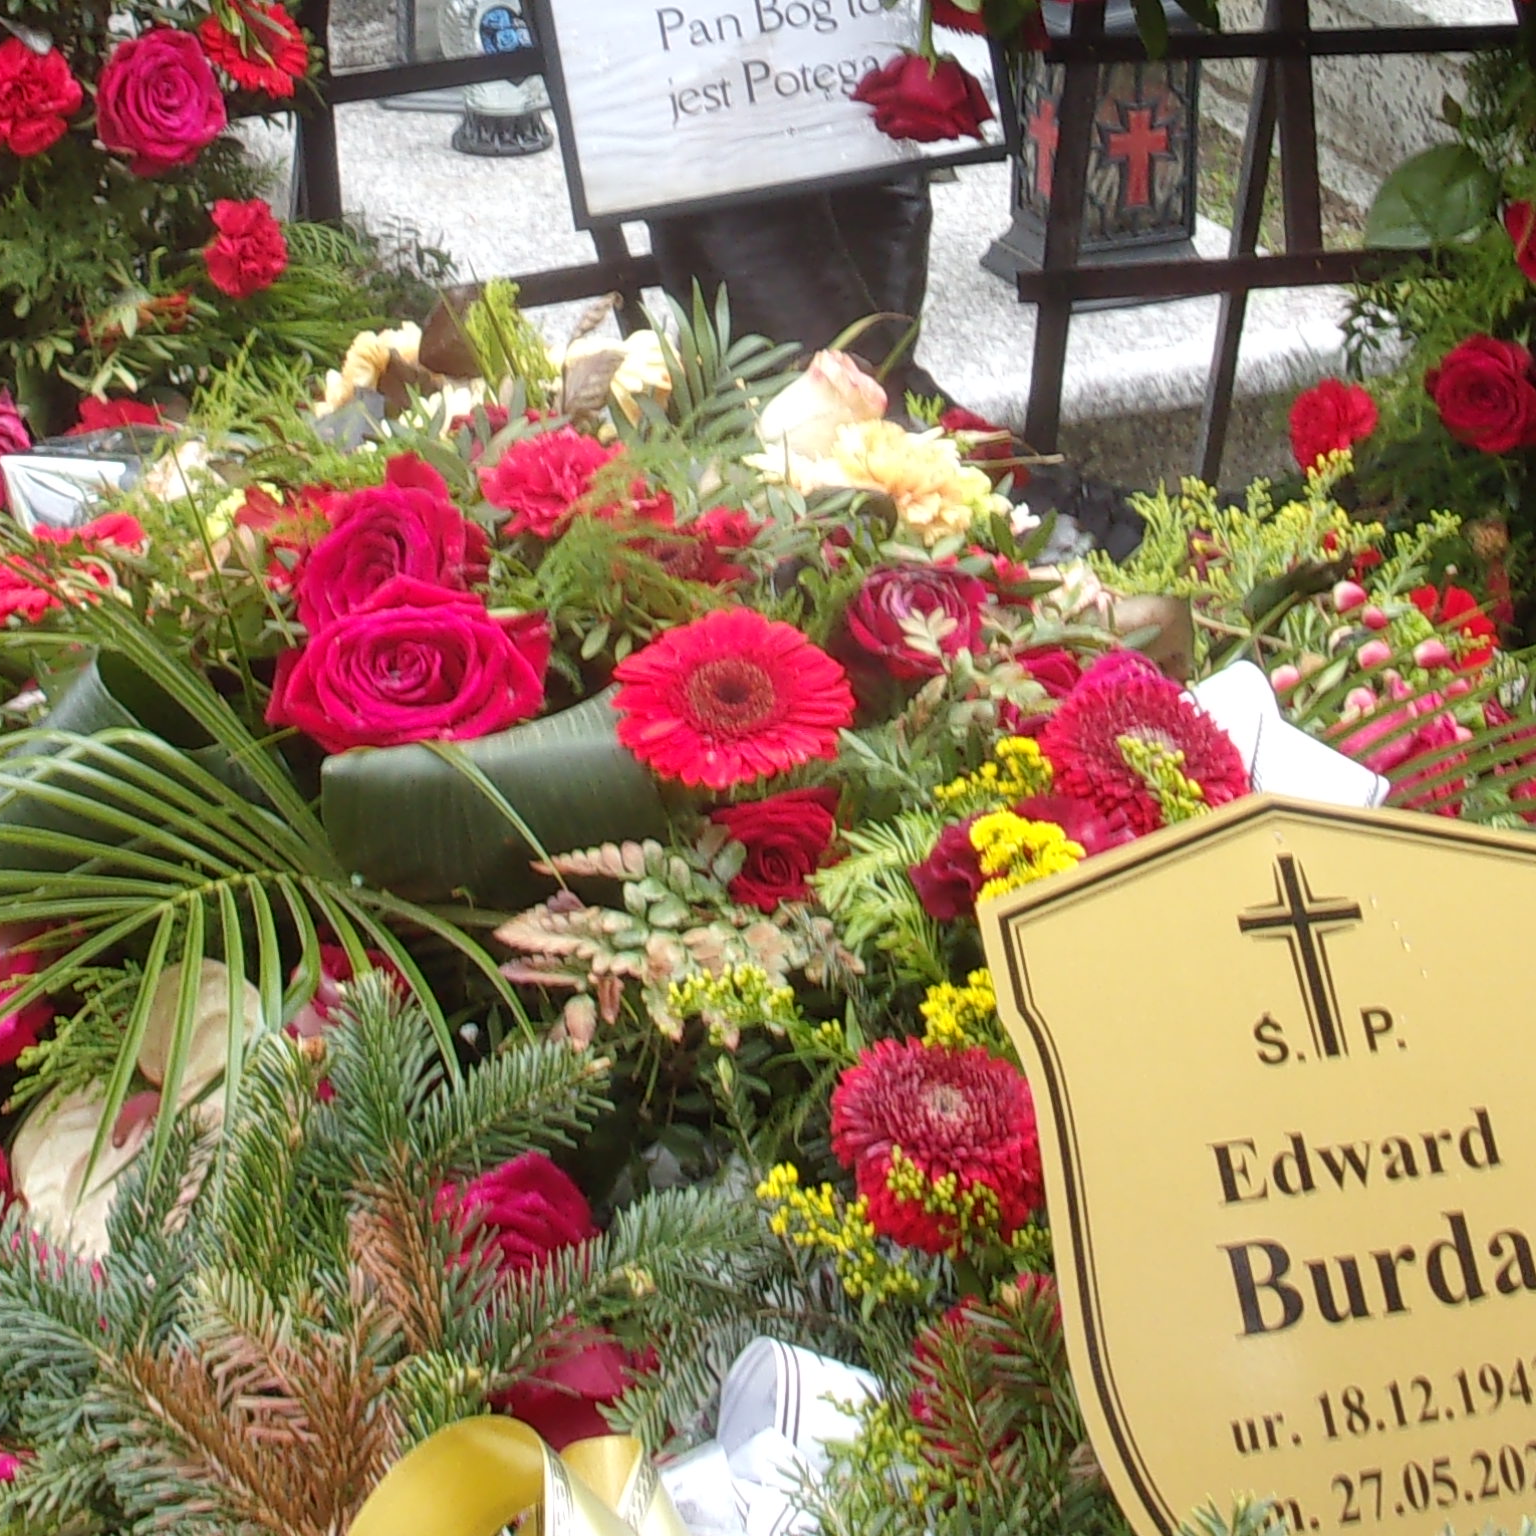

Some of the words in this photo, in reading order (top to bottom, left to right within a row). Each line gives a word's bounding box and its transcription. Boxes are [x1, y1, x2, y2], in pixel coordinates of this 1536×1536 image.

[655, 6, 743, 52] Pan
[667, 74, 733, 129] jest
[1359, 1005, 1408, 1053] P.
[1207, 1104, 1502, 1205] Edward
[1230, 1411, 1303, 1455] ur.
[1261, 1496, 1321, 1534] m.
